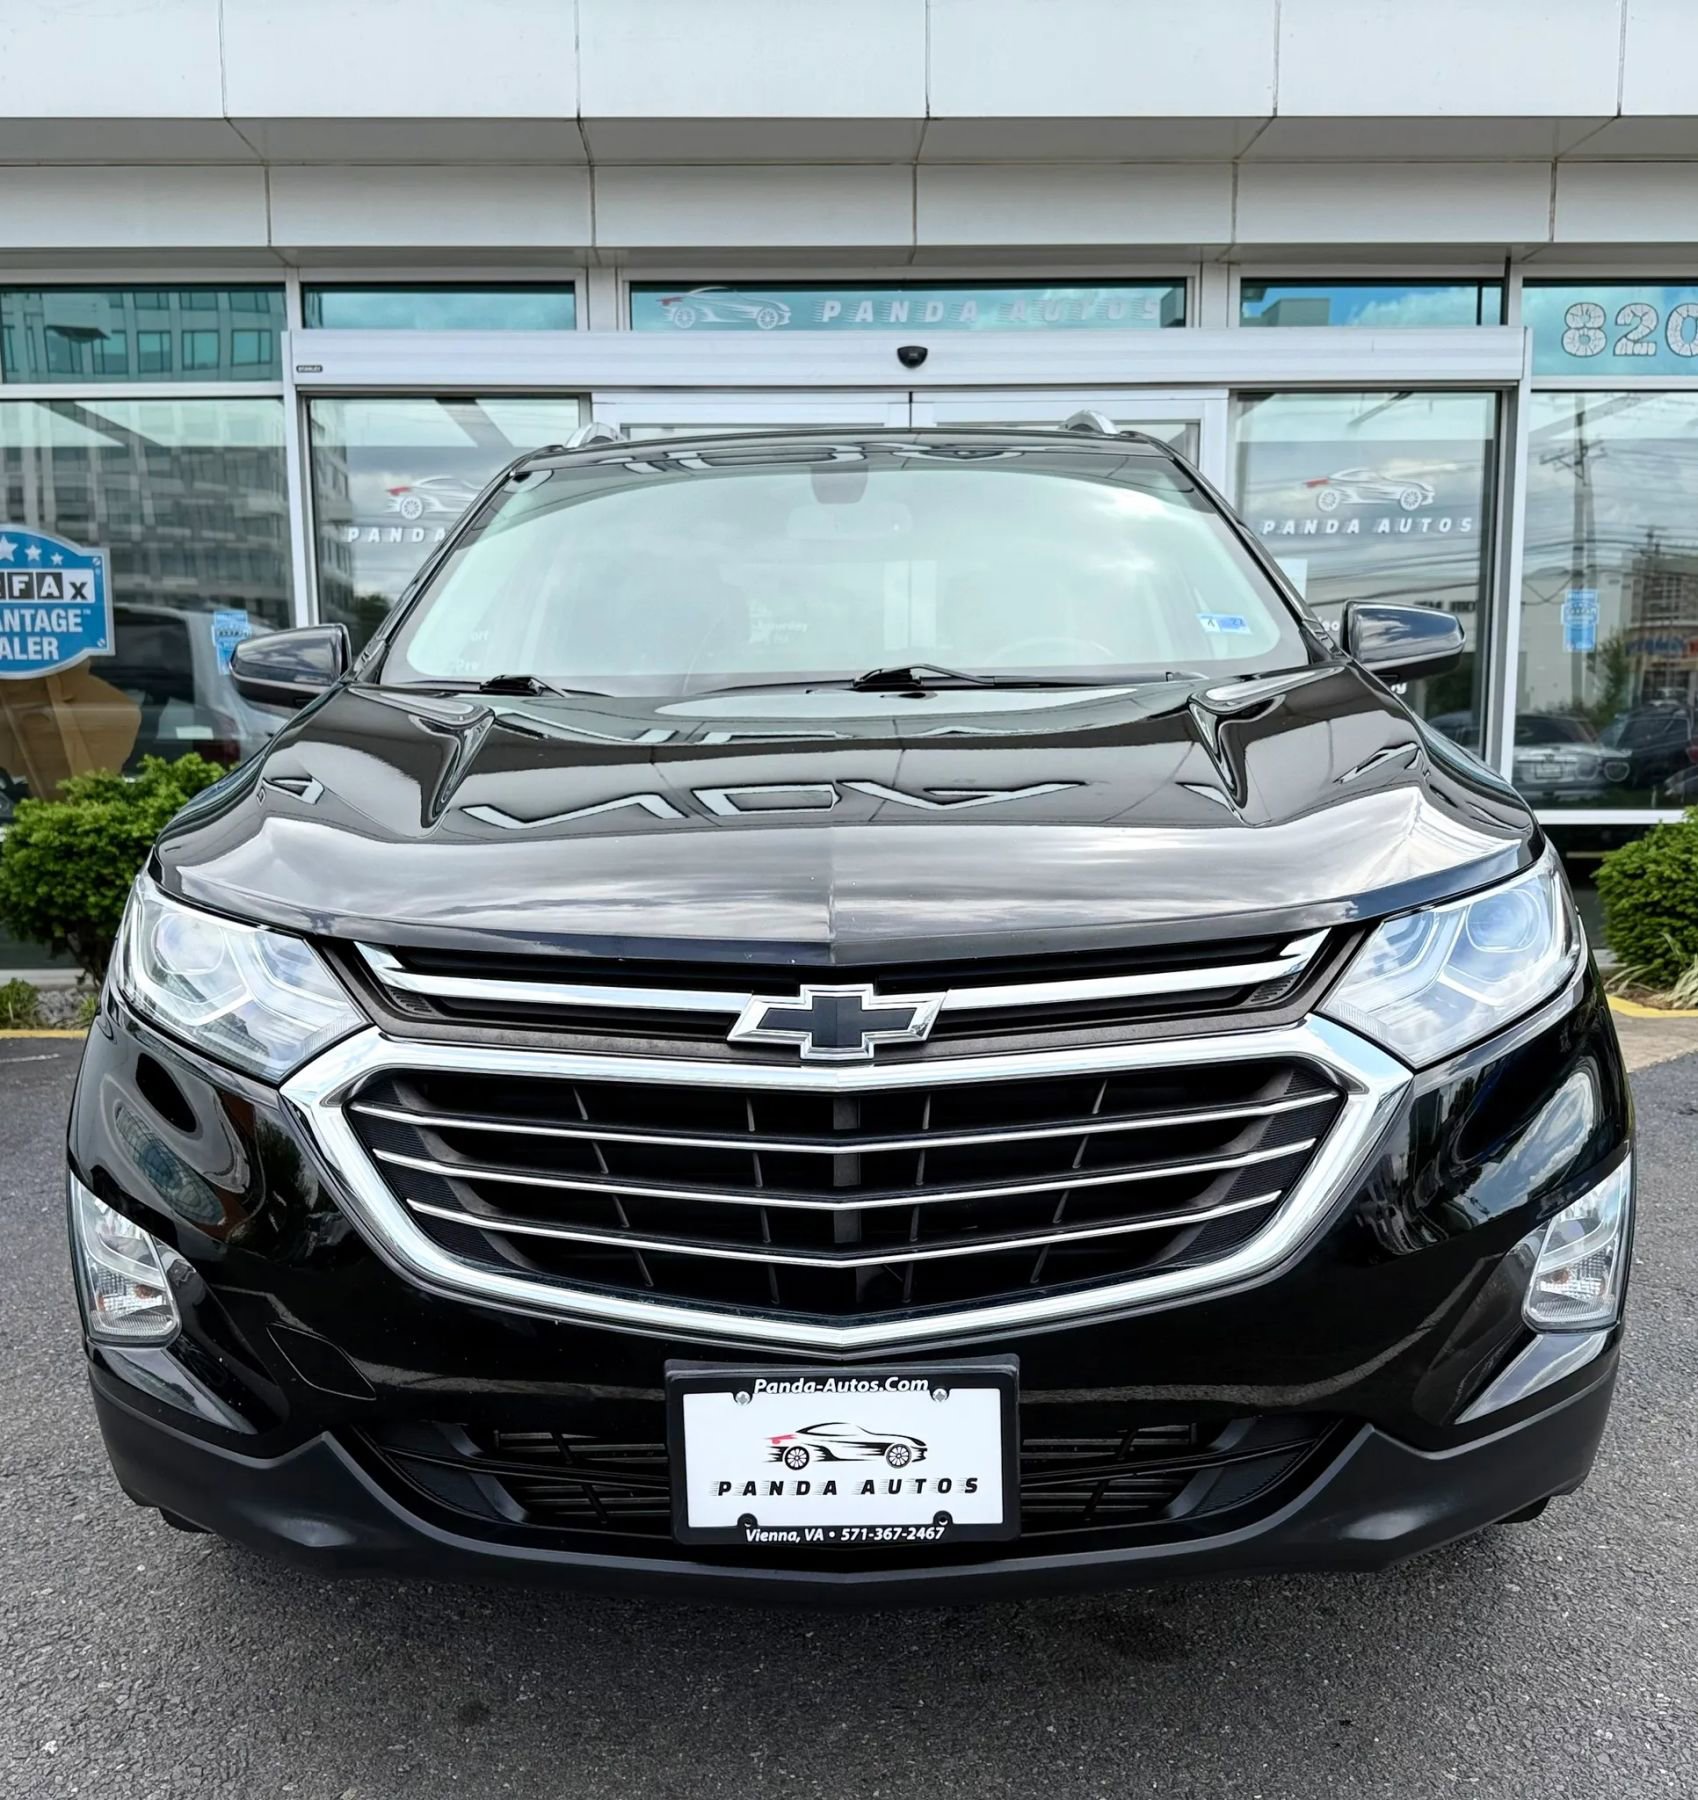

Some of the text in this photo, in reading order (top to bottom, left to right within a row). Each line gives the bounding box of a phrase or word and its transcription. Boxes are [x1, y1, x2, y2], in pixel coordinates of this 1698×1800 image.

[818, 298, 1159, 323] PANDA AUTOS
[347, 526, 446, 543] PANDA
[1262, 517, 1472, 535] PANDA AUTOS
[0, 573, 88, 601] FAX
[0, 607, 83, 633] NTAGE
[753, 1376, 929, 1394] Panda-Autos.Com
[715, 1477, 979, 1496] PANDA AUTOS
[745, 1527, 945, 1543] Vienna, VA 571-367-2467
